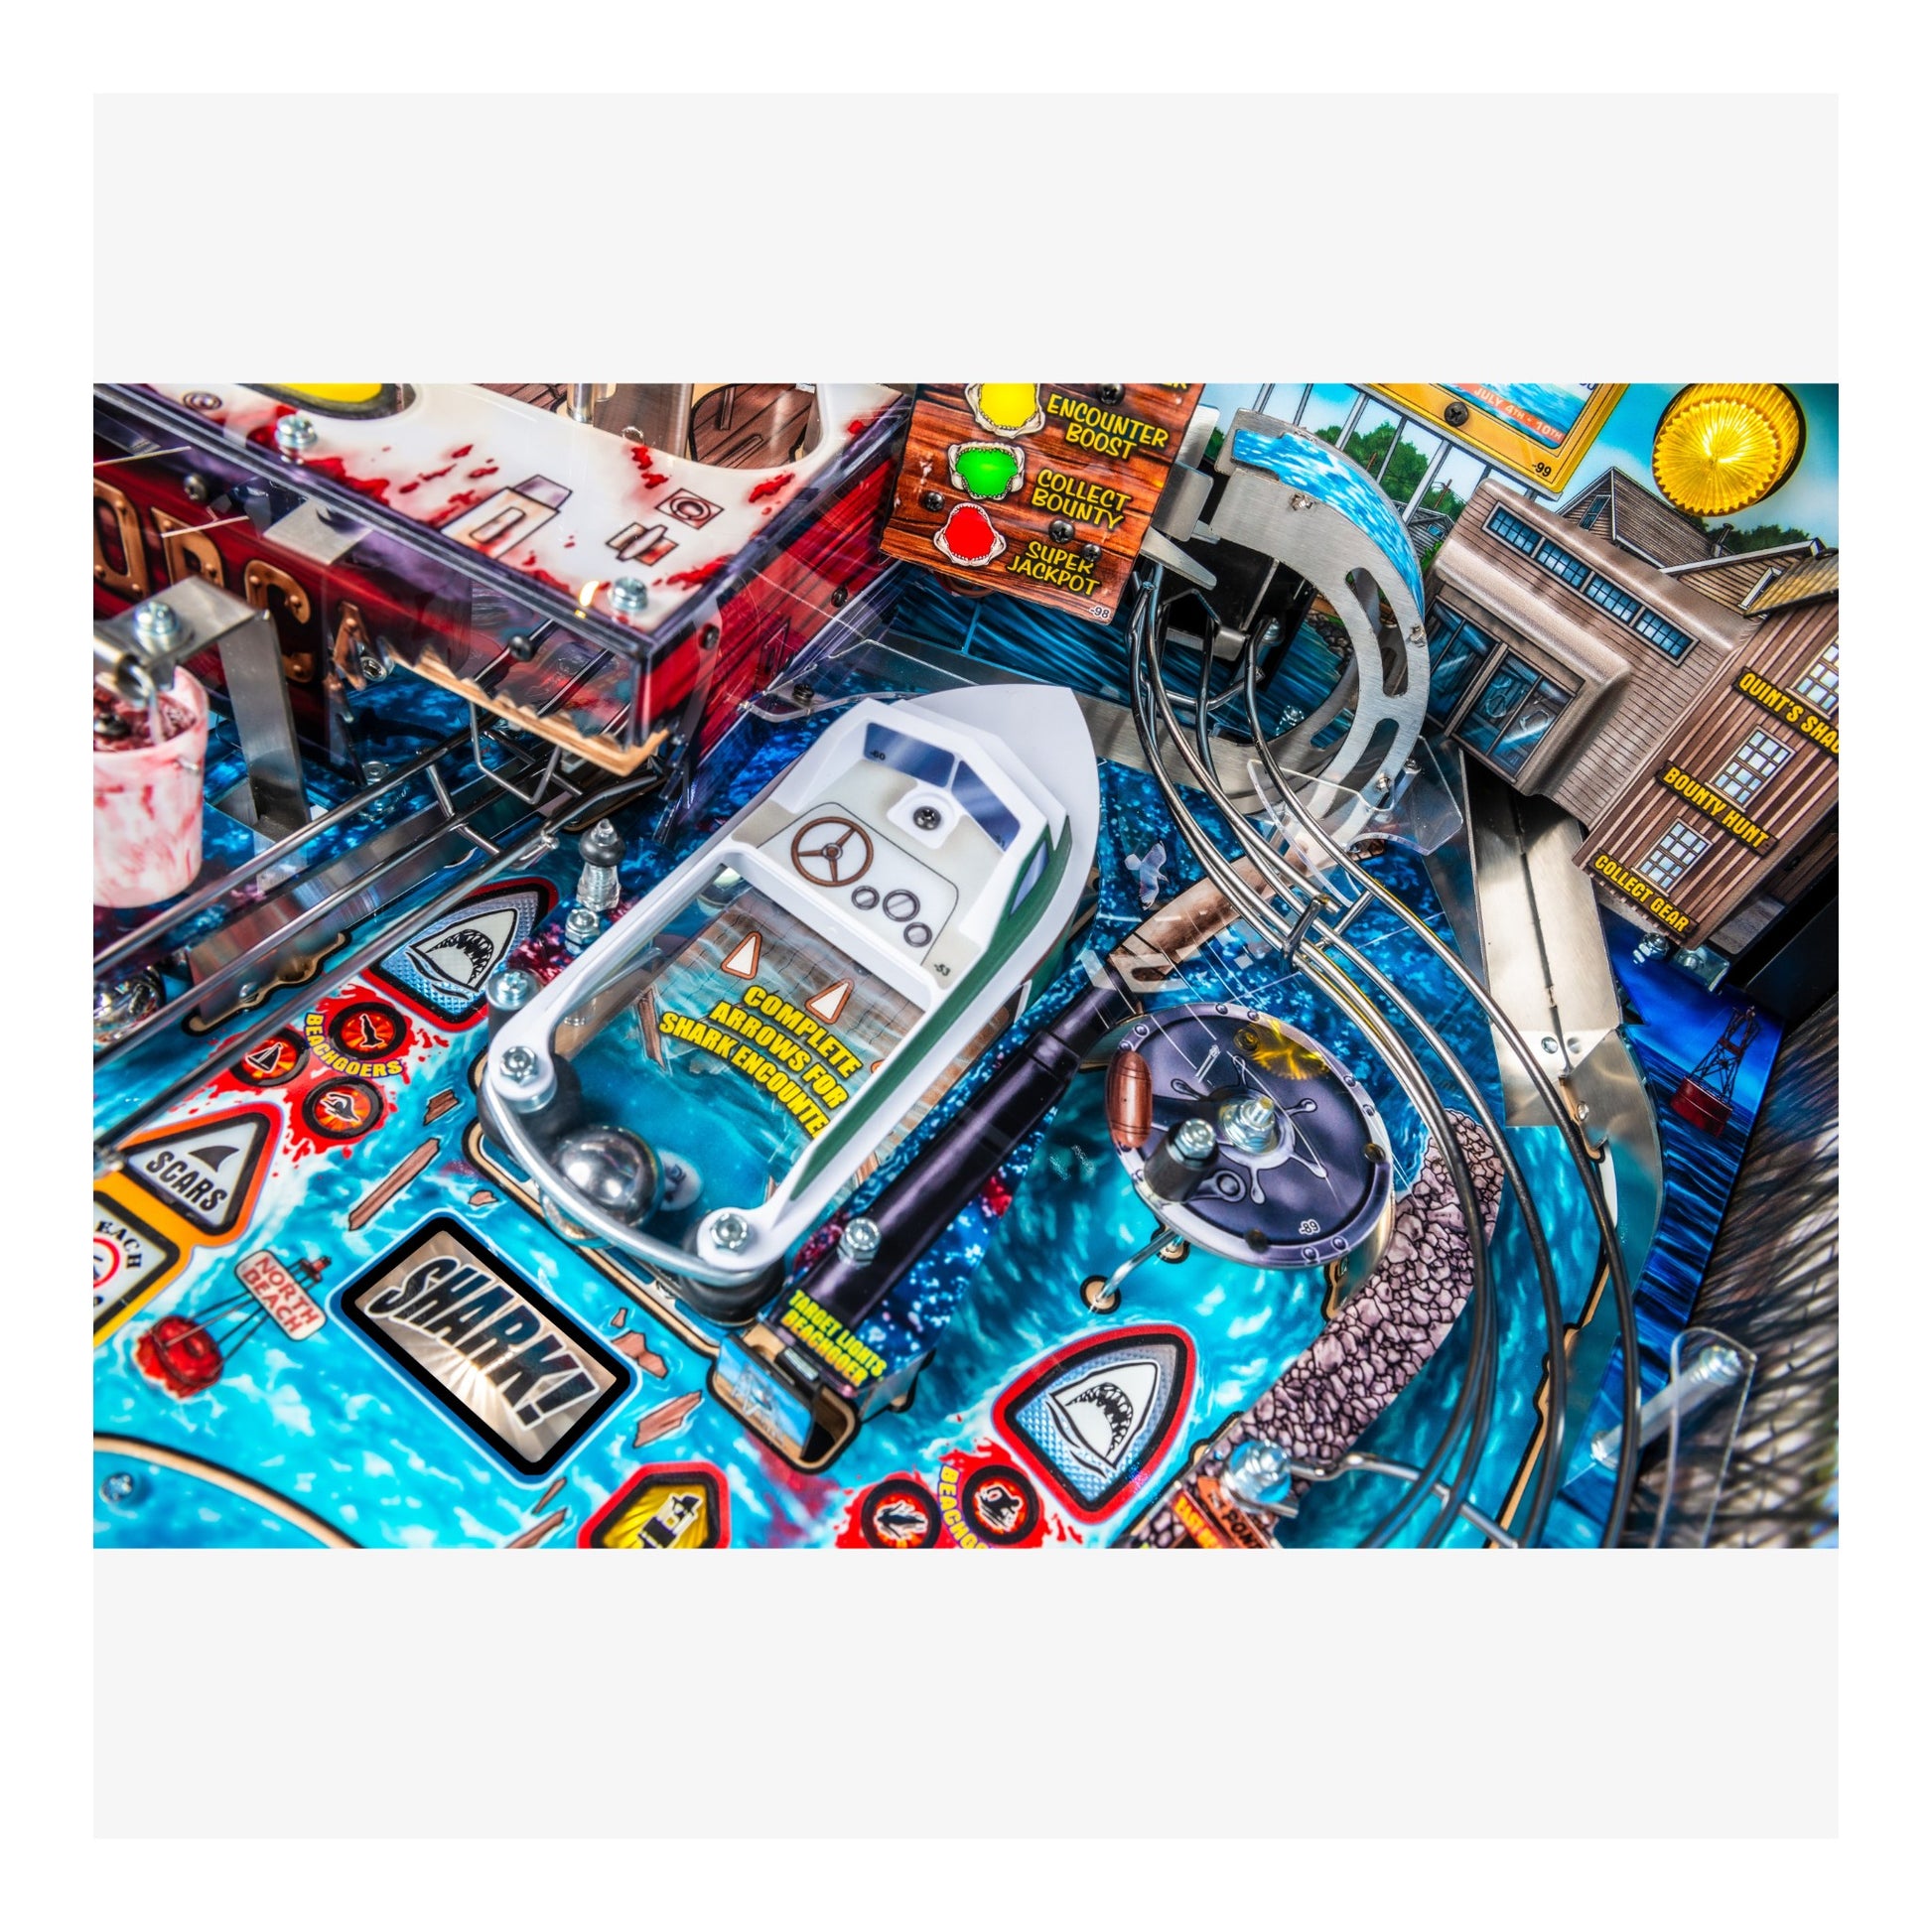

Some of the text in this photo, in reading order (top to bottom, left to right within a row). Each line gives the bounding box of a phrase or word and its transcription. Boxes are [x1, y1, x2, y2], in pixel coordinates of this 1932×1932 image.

[1046, 393, 1170, 448] ENCOUNTER
[1065, 423, 1138, 460] BOOST
[1473, 387, 1503, 408] JULY
[1535, 421, 1563, 440] 10TH
[1036, 469, 1131, 511] COLLECT
[1531, 462, 1552, 478] -99
[1031, 488, 1124, 530] BOUNTY
[1007, 555, 1100, 596] JACKPOT
[1026, 540, 1095, 574] SUPER
[1089, 606, 1110, 619] -98
[1738, 672, 1804, 723] QUINT'S
[1662, 766, 1770, 849] BOUNTY HUNT
[1594, 854, 1691, 933] COLLECT GEAR
[933, 962, 951, 977] -53
[305, 1012, 404, 1078] BEACHGOERS
[709, 1000, 850, 1110] ARROWS FOR
[743, 985, 863, 1079] COMPLETE
[658, 1011, 831, 1139] SHARK ENCOUNTE
[146, 1150, 226, 1213] SCARS
[1300, 1219, 1320, 1235] -89
[242, 1270, 304, 1334] BEACH
[255, 1255, 321, 1325] NORTH
[364, 1255, 600, 1431] SHARK!
[781, 1309, 869, 1387] BEACHGOER
[788, 1289, 888, 1377] TARGET LIGHTS
